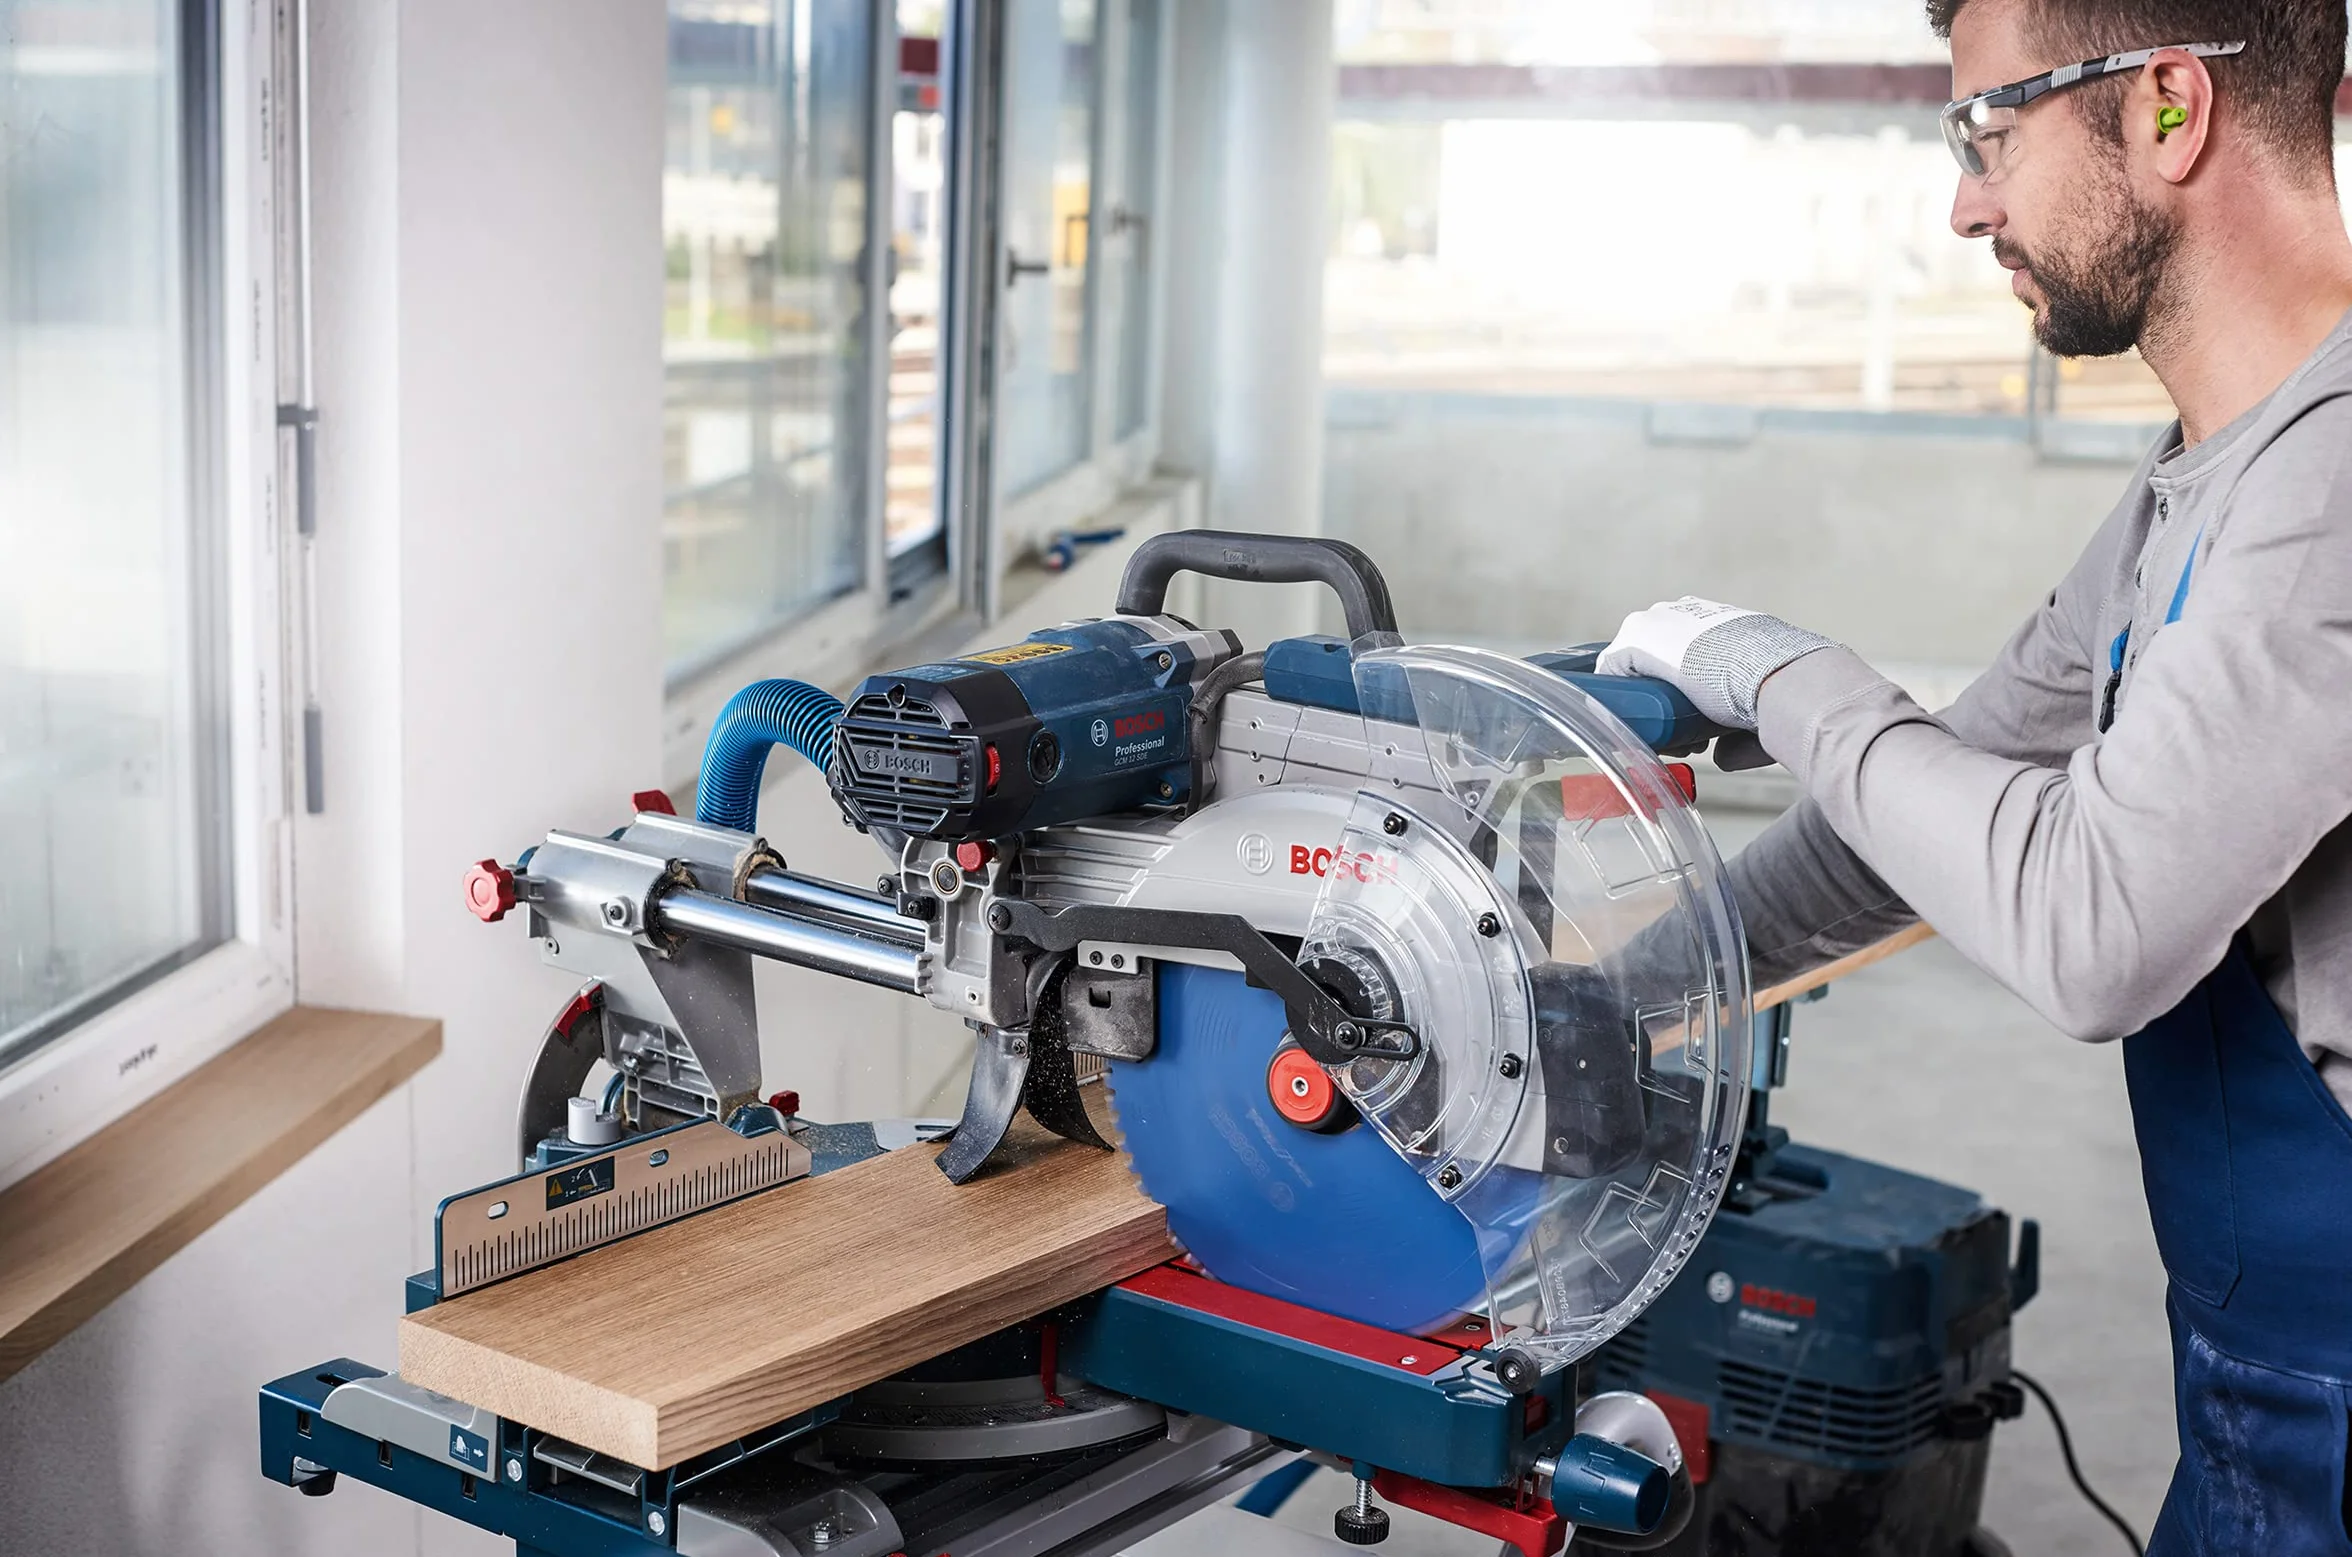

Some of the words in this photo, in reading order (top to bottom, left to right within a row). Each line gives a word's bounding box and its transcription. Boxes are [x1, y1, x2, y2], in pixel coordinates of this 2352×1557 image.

[1114, 709, 1165, 739] BOSCH
[1115, 736, 1165, 757] Professional
[885, 755, 932, 774] BOSCH
[1114, 756, 1128, 766] GCM
[1128, 755, 1136, 763] 12
[1290, 844, 1399, 885] BOSCH
[1740, 1283, 1816, 1318] BOSCH
